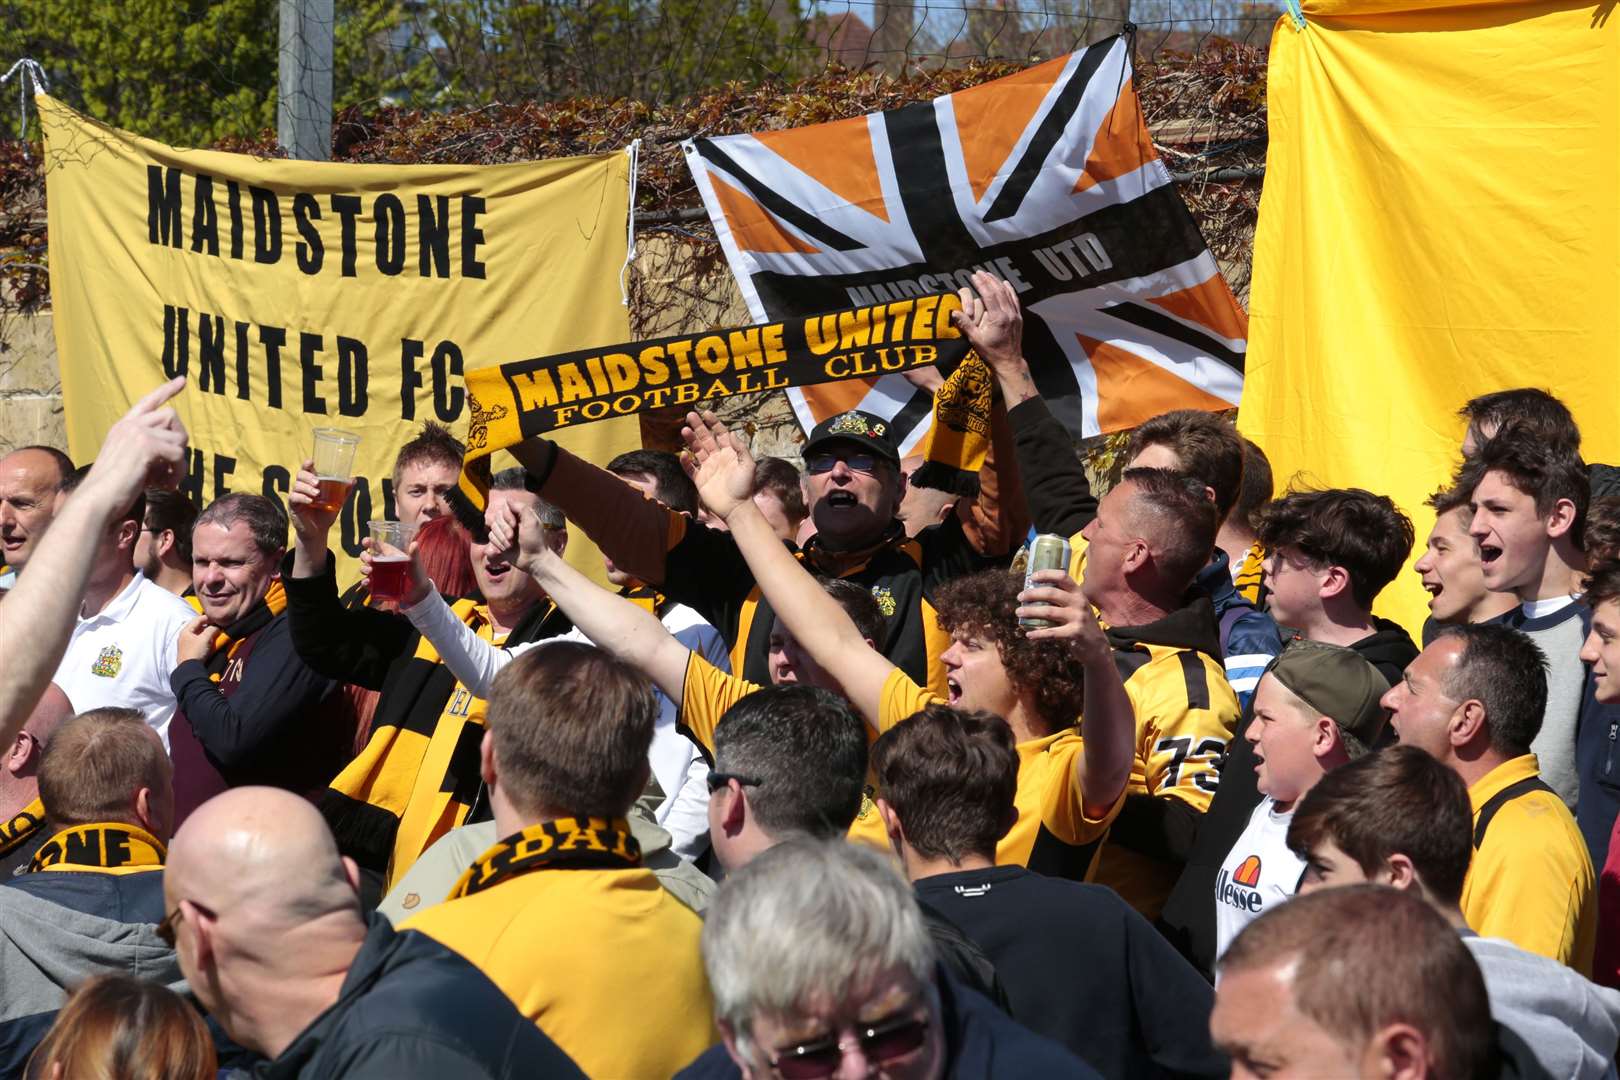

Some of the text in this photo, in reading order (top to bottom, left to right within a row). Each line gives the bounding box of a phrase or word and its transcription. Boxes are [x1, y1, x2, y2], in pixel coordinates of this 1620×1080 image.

[147, 164, 487, 280] MAIDSTONE
[1031, 232, 1113, 282] UTD
[162, 304, 466, 422] UNITED FC
[511, 323, 788, 412] MAIDSTONE
[553, 344, 938, 427] FOOTBALL CLUB
[1215, 867, 1263, 913] llesse
